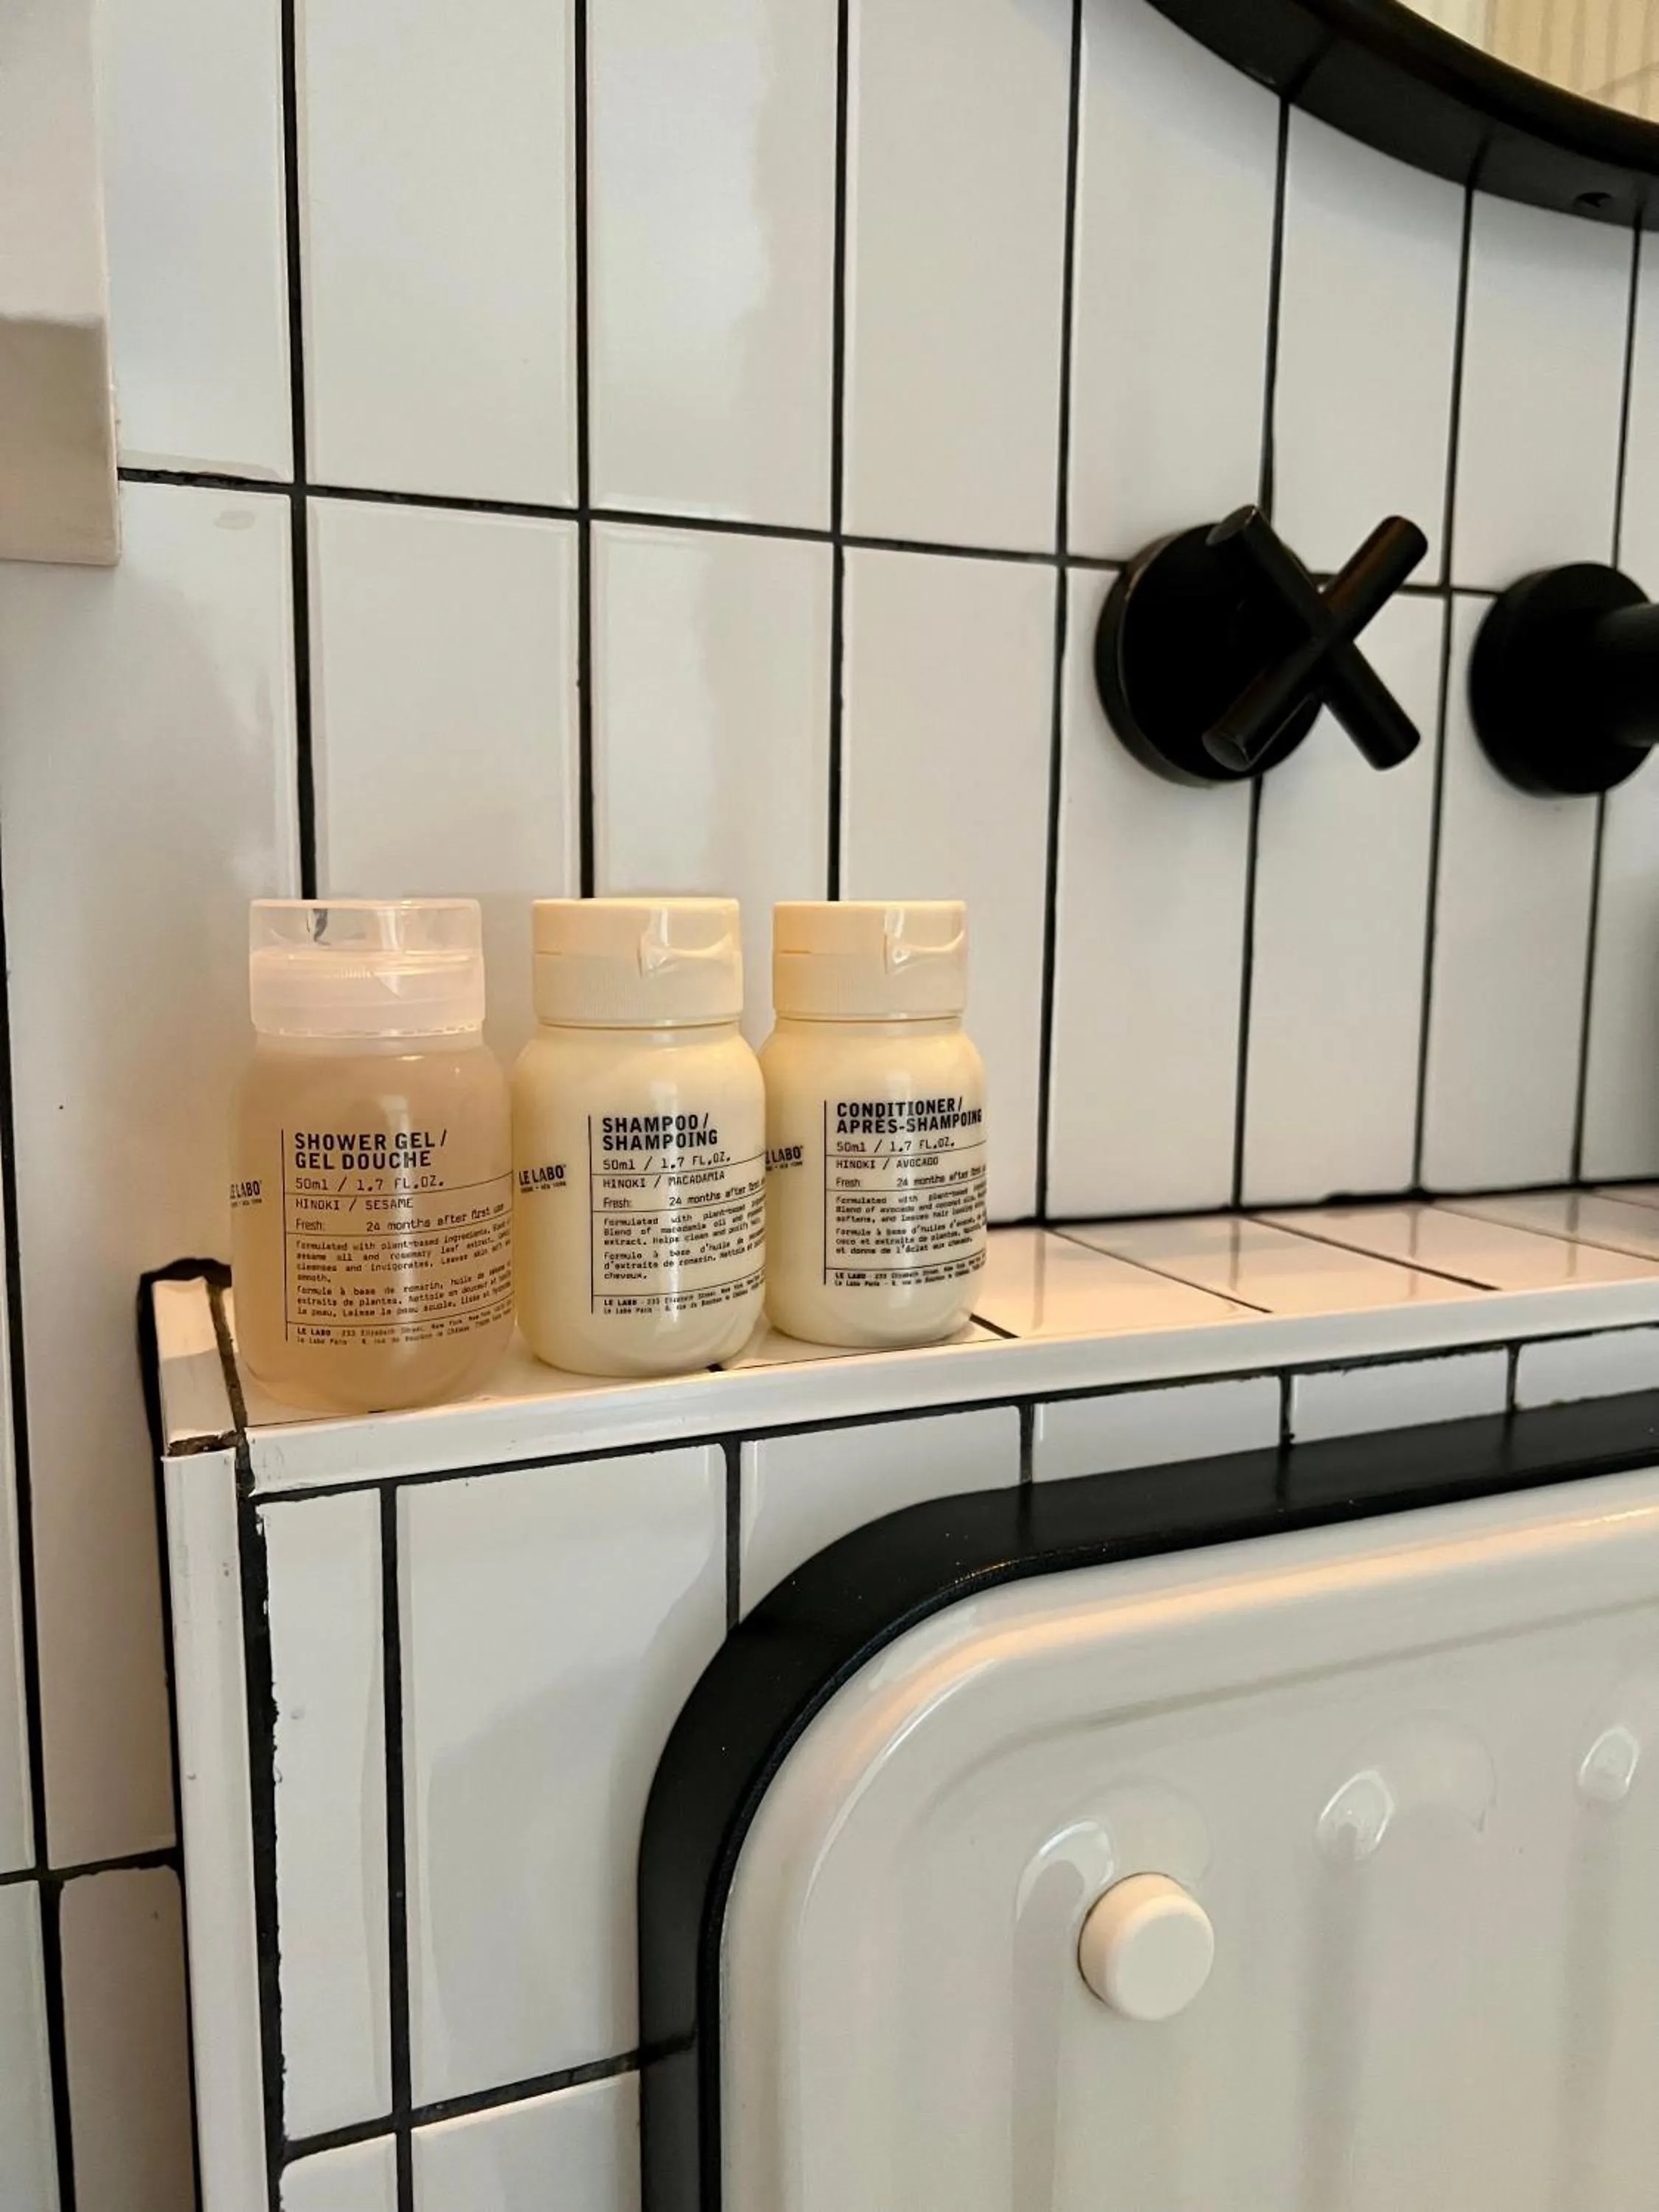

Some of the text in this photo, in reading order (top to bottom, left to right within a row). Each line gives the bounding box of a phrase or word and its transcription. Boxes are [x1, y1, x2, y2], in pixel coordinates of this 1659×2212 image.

[837, 1096, 962, 1117] CONDITIONER/
[295, 1133, 386, 1151] SHOWER
[602, 1130, 717, 1151] SHAMPOING
[837, 1141, 866, 1152] 50ml
[891, 1141, 911, 1152] 1.7
[296, 1150, 431, 1170] GEL DOUCHE
[603, 1159, 636, 1171] 50ml
[661, 1157, 685, 1169] 1.7
[836, 1160, 875, 1169] HINOKI
[897, 1156, 939, 1168] AVOCADO
[518, 1165, 564, 1186] LE LABO
[603, 1178, 646, 1189] HINOKI
[669, 1171, 725, 1186] MACADAMIA
[296, 1178, 329, 1191] 50ml
[357, 1178, 383, 1192] 1.7
[296, 1198, 340, 1210] HINOKI
[365, 1197, 414, 1210] SESAME
[669, 1197, 682, 1206] 24
[687, 1191, 721, 1204] months
[725, 1186, 746, 1198] after
[366, 1222, 380, 1232] 24
[388, 1219, 431, 1231] months
[437, 1213, 467, 1225] after
